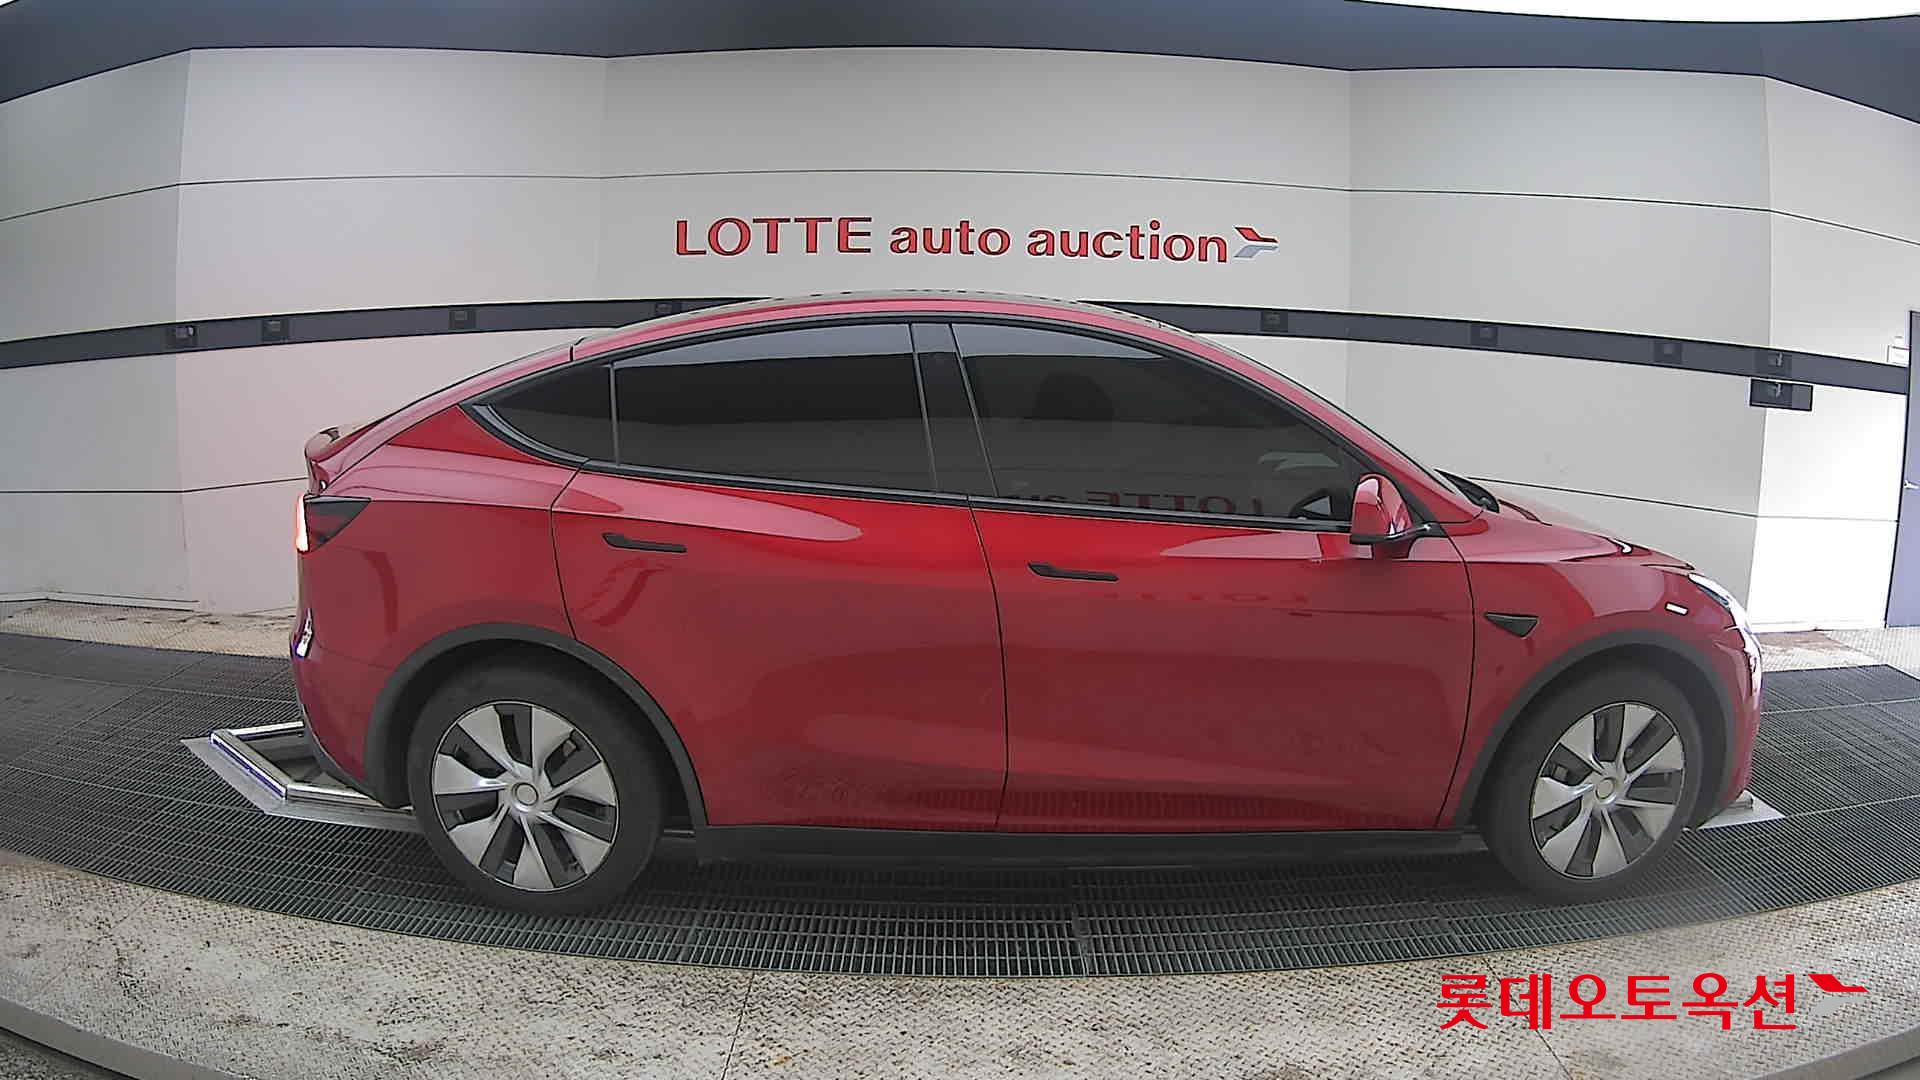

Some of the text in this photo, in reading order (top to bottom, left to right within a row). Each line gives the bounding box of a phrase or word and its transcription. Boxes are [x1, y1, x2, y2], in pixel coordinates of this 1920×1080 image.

[676, 217, 1228, 263] LOTTE auto auction
